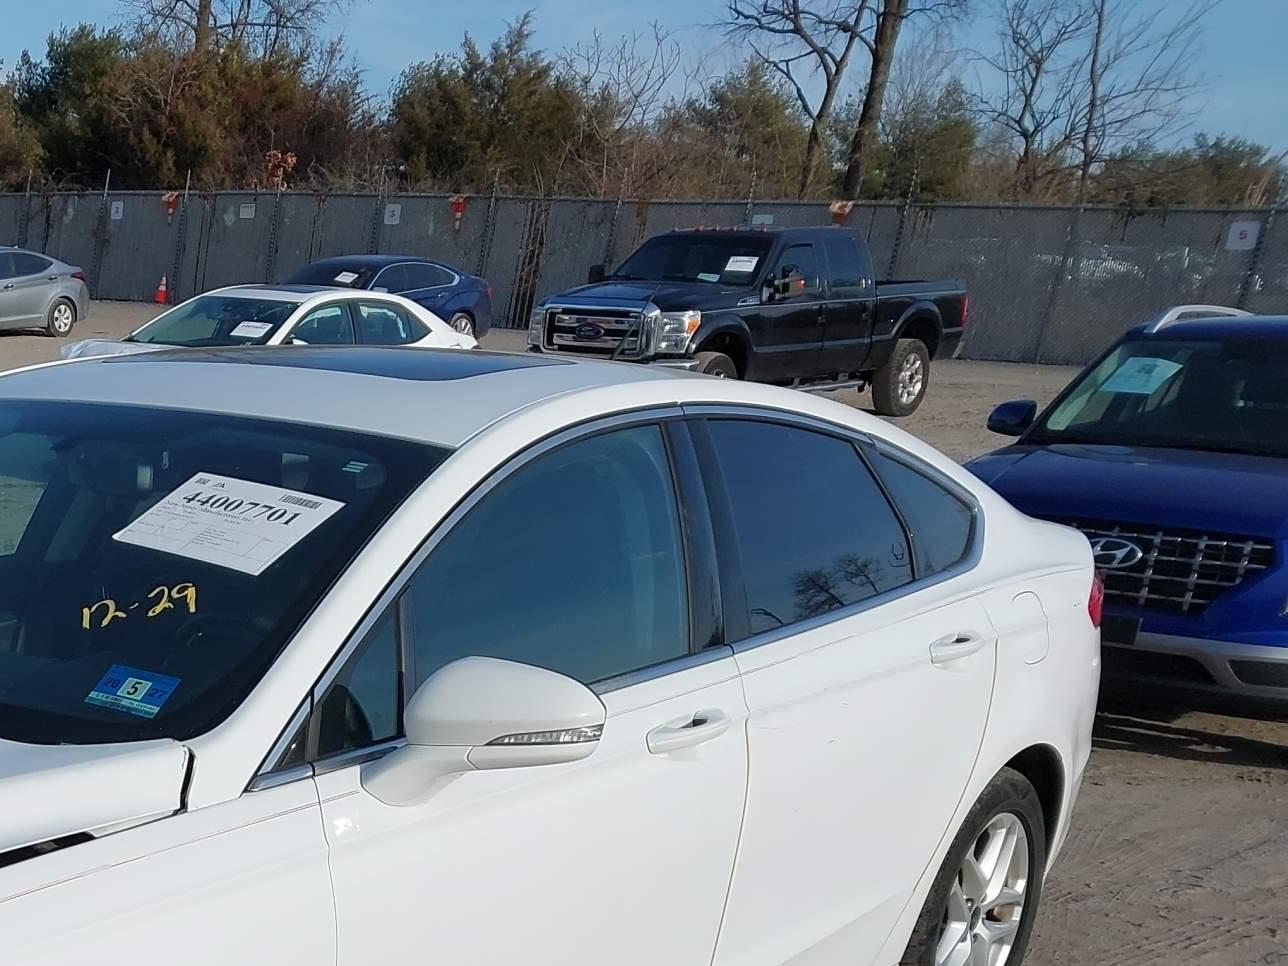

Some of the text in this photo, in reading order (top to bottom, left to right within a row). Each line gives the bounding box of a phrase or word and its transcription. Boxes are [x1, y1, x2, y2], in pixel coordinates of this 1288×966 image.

[389, 209, 396, 218] 3
[1239, 229, 1248, 240] 5
[181, 490, 302, 526] 44007701
[103, 677, 168, 699] 20 5 27
